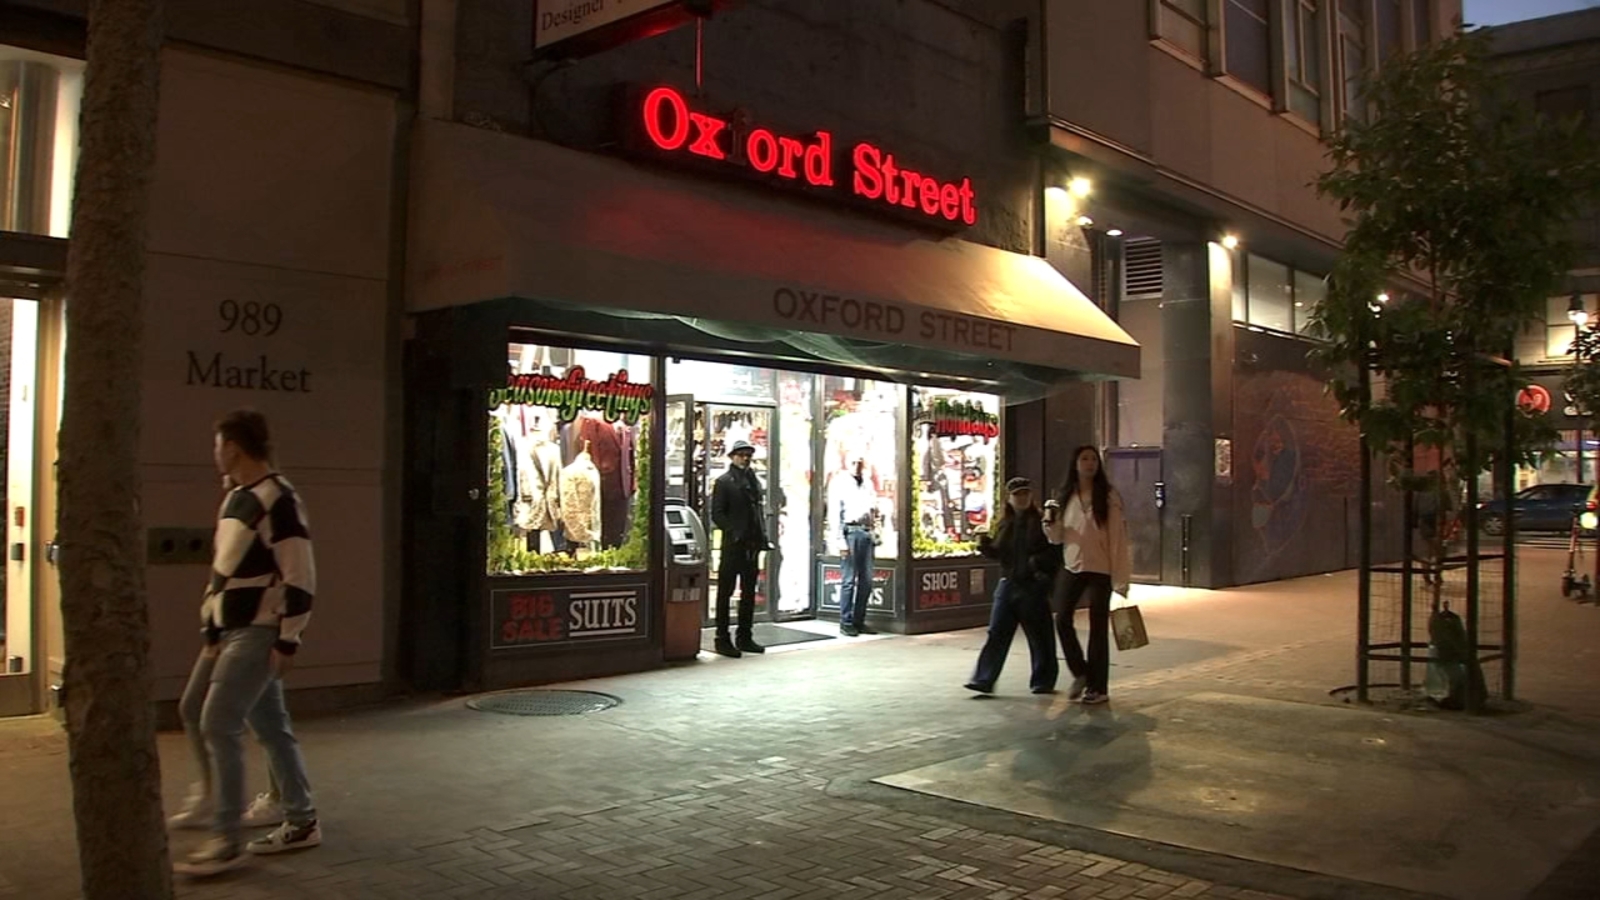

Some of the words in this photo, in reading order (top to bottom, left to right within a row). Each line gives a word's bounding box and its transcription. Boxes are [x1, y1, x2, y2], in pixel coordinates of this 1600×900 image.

[541, 0, 604, 31] Designer
[853, 143, 976, 226] Street
[218, 299, 283, 337] 989
[773, 287, 905, 334] OXFORD
[919, 310, 1017, 352] STREET
[186, 350, 313, 393] Market
[921, 570, 959, 592] SHOE
[508, 593, 554, 618] BIG
[568, 596, 637, 630] SUITS
[502, 616, 562, 642] SALE
